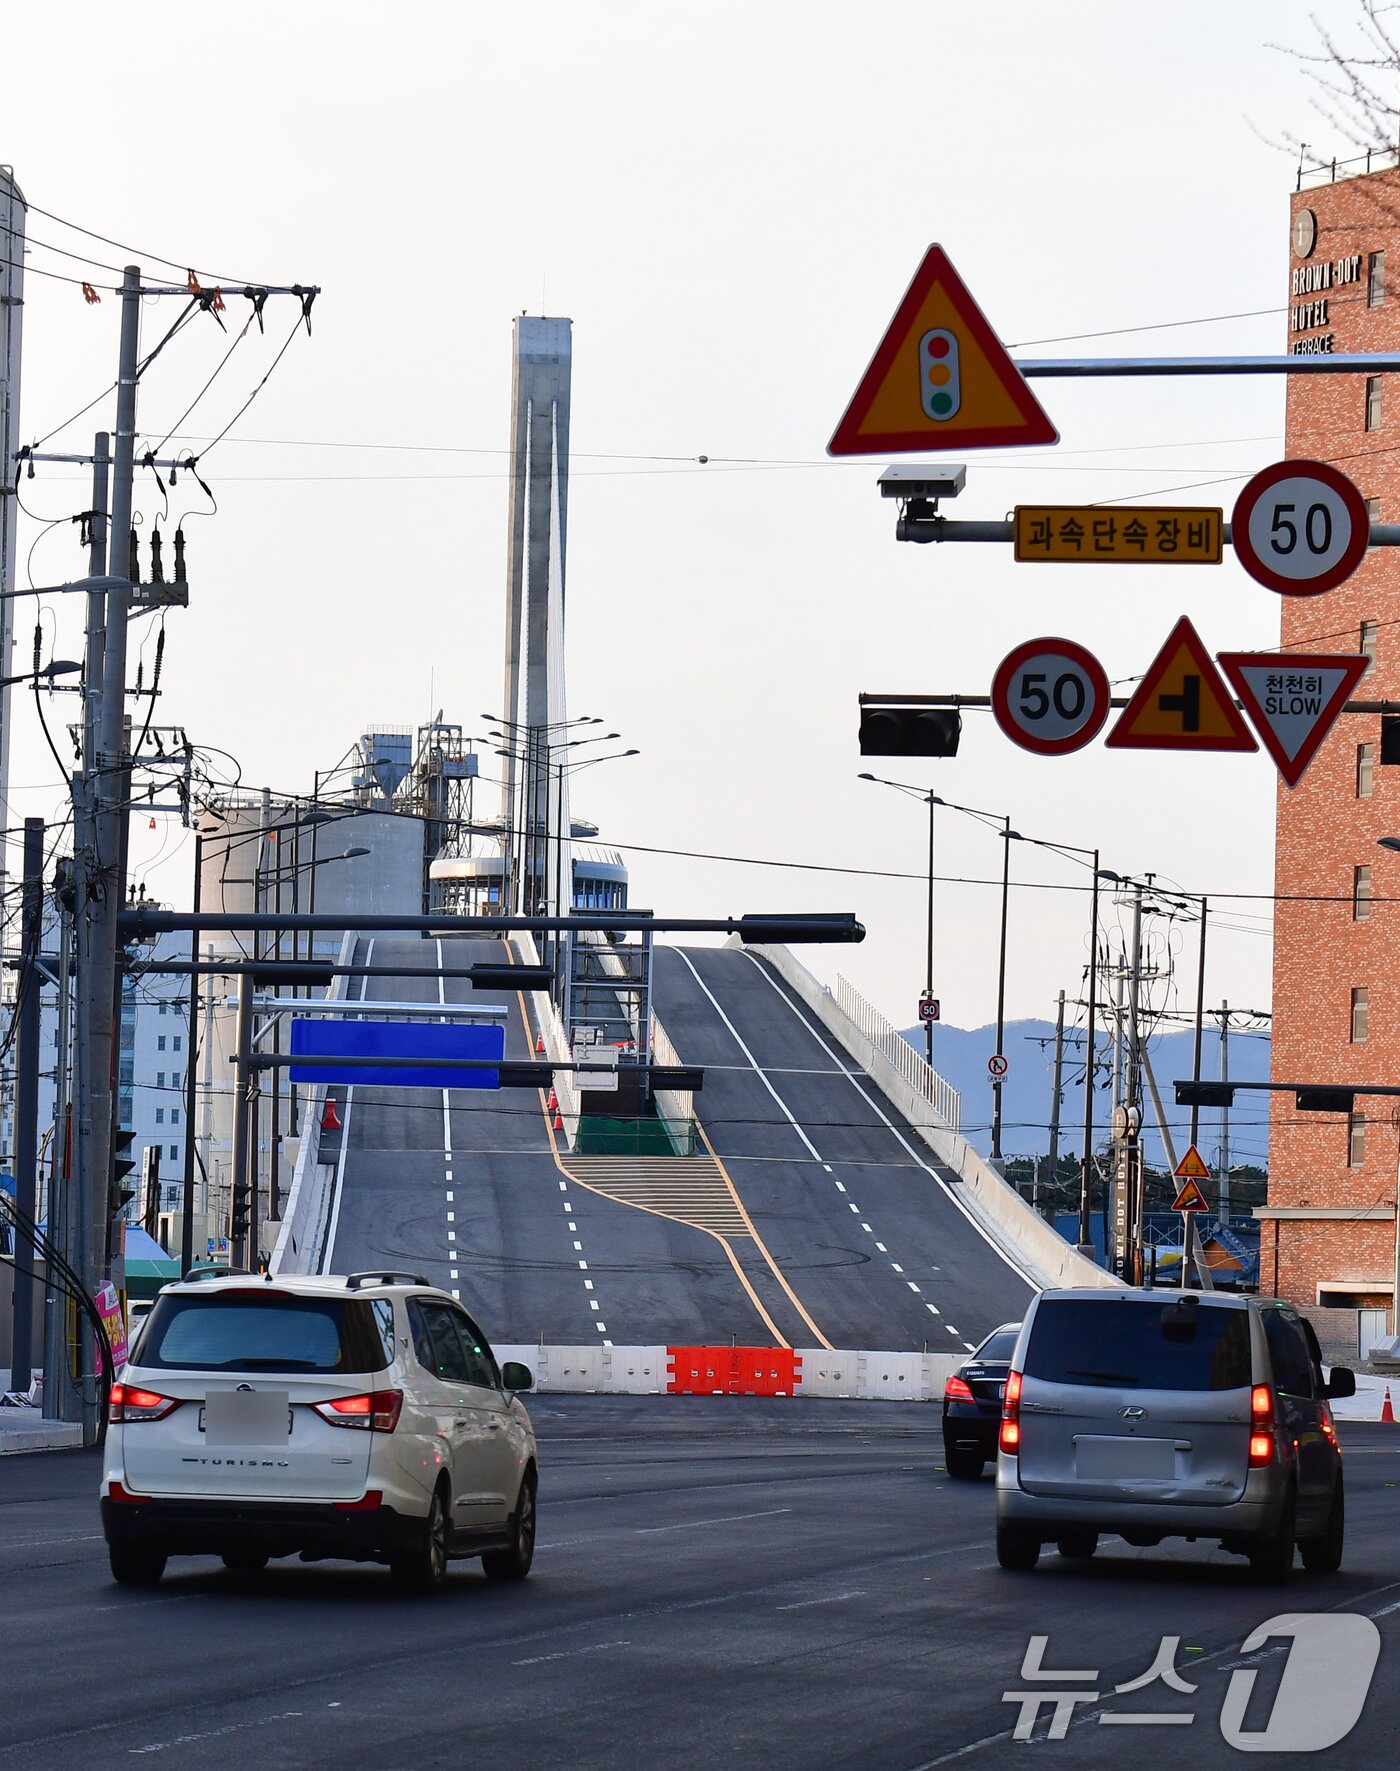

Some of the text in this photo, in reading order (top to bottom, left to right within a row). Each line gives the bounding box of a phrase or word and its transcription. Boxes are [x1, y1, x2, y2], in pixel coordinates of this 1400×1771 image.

[1291, 300, 1327, 332] HOTEL
[1291, 334, 1331, 355] TERRACE
[1027, 517, 1211, 553] 과속단속장비
[1270, 503, 1332, 555] 50
[1264, 674, 1323, 696] 천천히
[1019, 673, 1086, 721] 50
[1264, 697, 1322, 716] SLOW
[923, 1005, 936, 1015] 50
[199, 1458, 289, 1467] TURISMO
